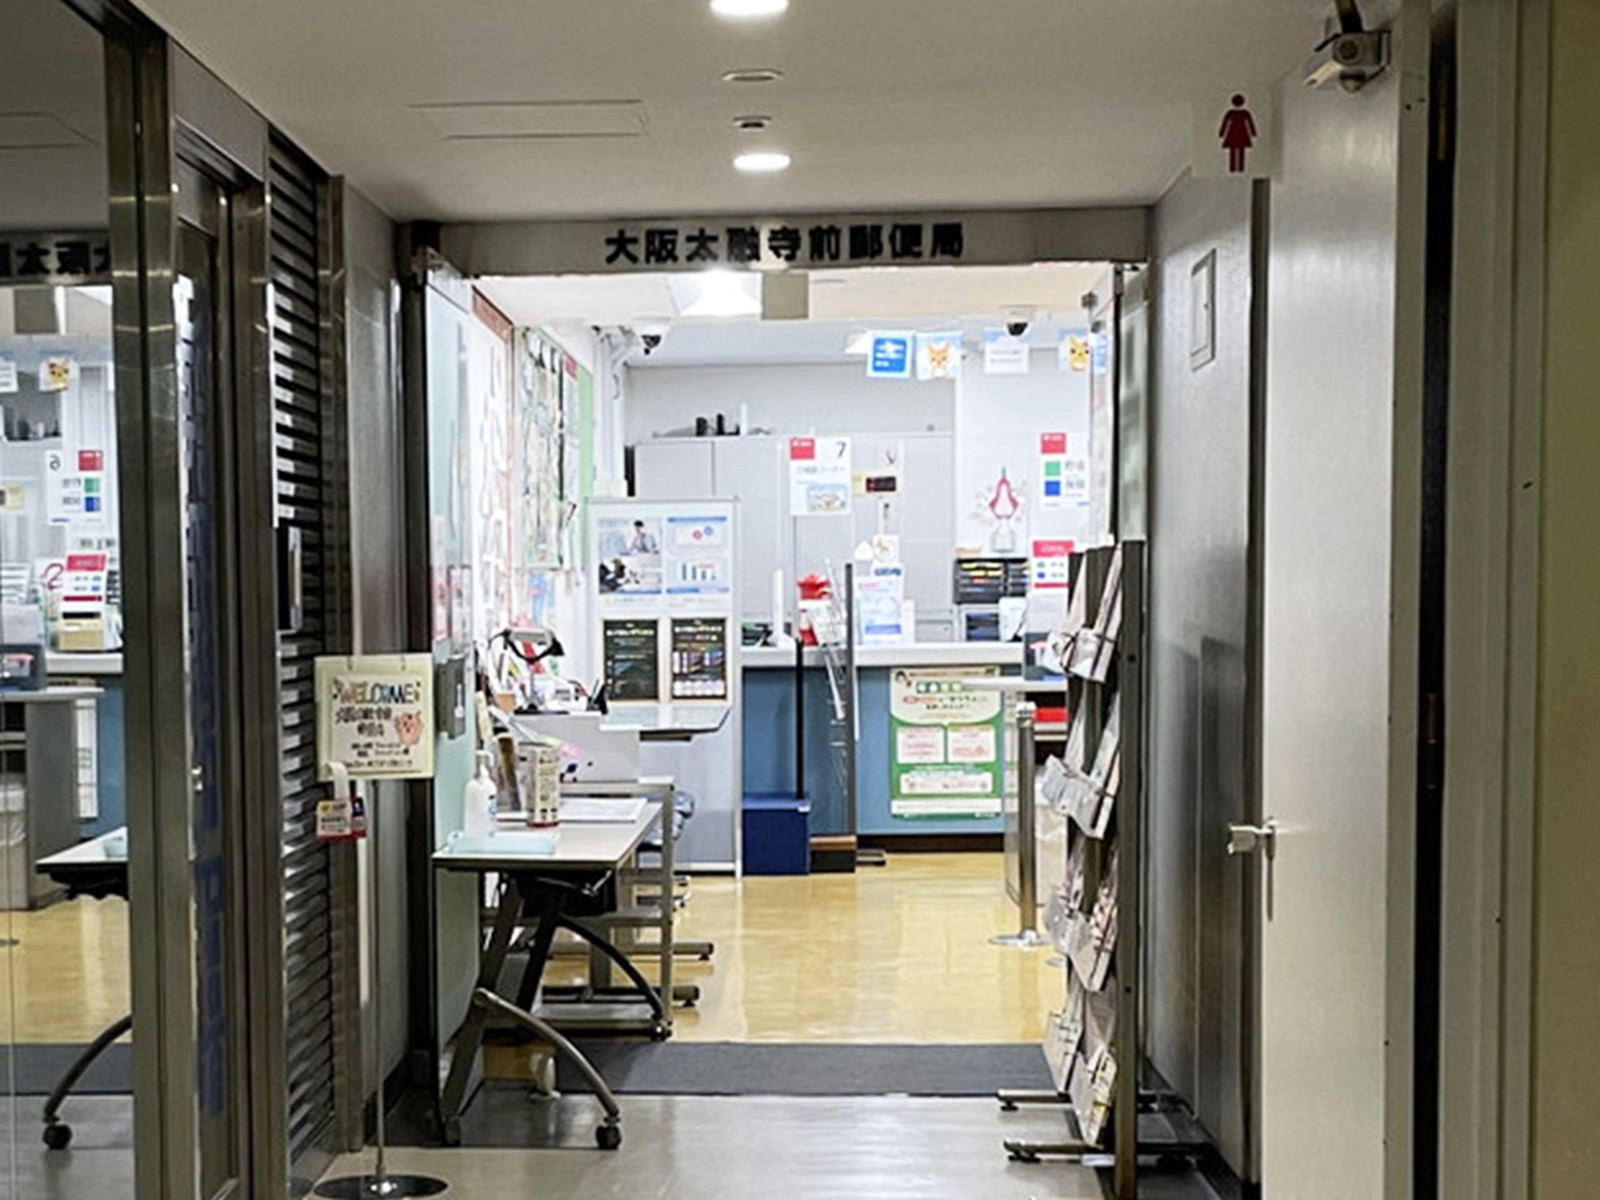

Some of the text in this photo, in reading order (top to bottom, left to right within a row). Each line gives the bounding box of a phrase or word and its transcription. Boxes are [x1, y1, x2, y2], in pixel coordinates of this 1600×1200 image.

[605, 224, 964, 264] 大阪太融寺前郵便局
[836, 441, 847, 458] 7
[339, 682, 415, 705] WELCOME
